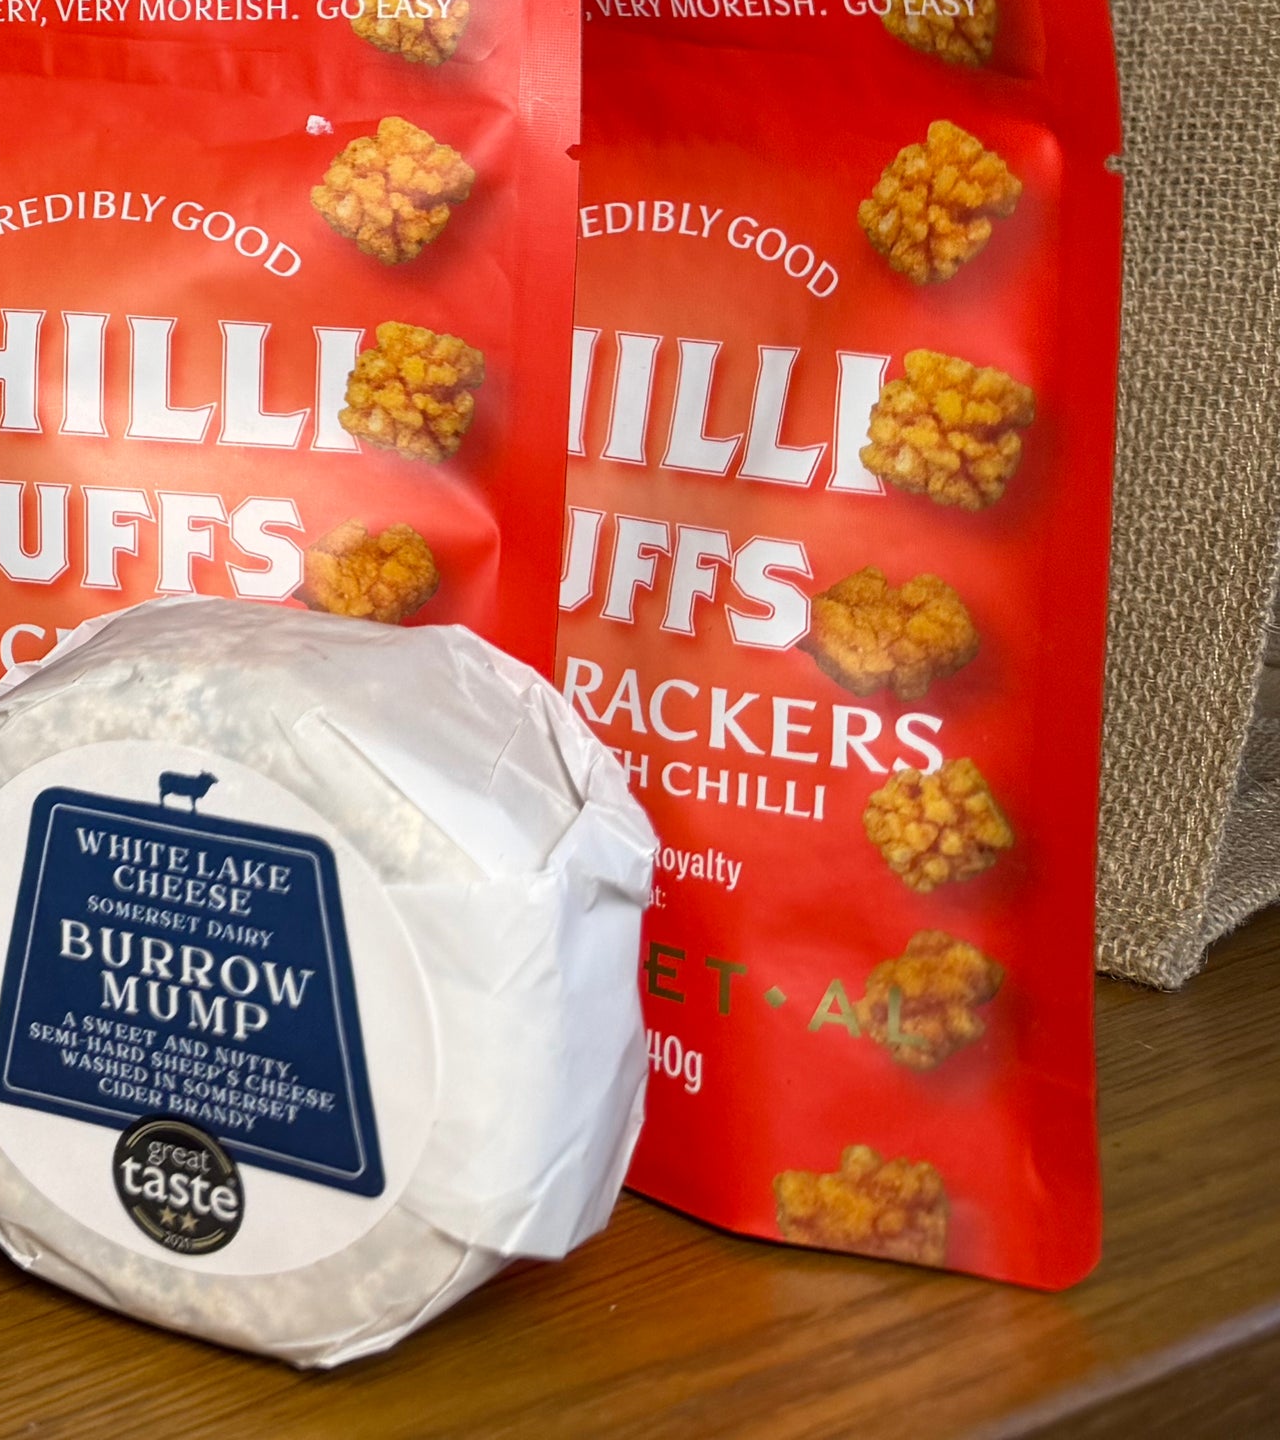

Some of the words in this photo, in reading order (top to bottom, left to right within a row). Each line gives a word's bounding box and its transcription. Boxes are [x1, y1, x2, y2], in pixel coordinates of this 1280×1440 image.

[172, 201, 302, 278] GOOD
[578, 200, 722, 239] EDIBLY
[727, 216, 840, 299] GOOD
[661, 761, 826, 822] CHILLI
[76, 827, 190, 873] WHITE
[197, 852, 291, 895] LAKE
[113, 865, 253, 917] CHEESE
[88, 895, 201, 935] SOMERSET
[207, 920, 275, 950] DAIRY
[59, 918, 316, 1009] BURROW
[101, 970, 270, 1041] MUMP
[30, 1021, 145, 1062] SEMI-HARD
[151, 1051, 240, 1086] SHEEP'S
[244, 1072, 335, 1112] CHEESE
[62, 1012, 76, 1028] A
[83, 1015, 158, 1046] SWEET
[163, 1035, 209, 1058] AND
[215, 1046, 299, 1083] NUTTY,
[645, 1029, 703, 1094] 40g
[61, 1049, 148, 1083] WASHED
[154, 1072, 177, 1090] IN
[182, 1080, 299, 1124] SOMERSET
[99, 1077, 163, 1107] CIDER
[169, 1093, 258, 1133] BRANDY
[120, 1156, 238, 1222] taste
[147, 1140, 211, 1174] great
